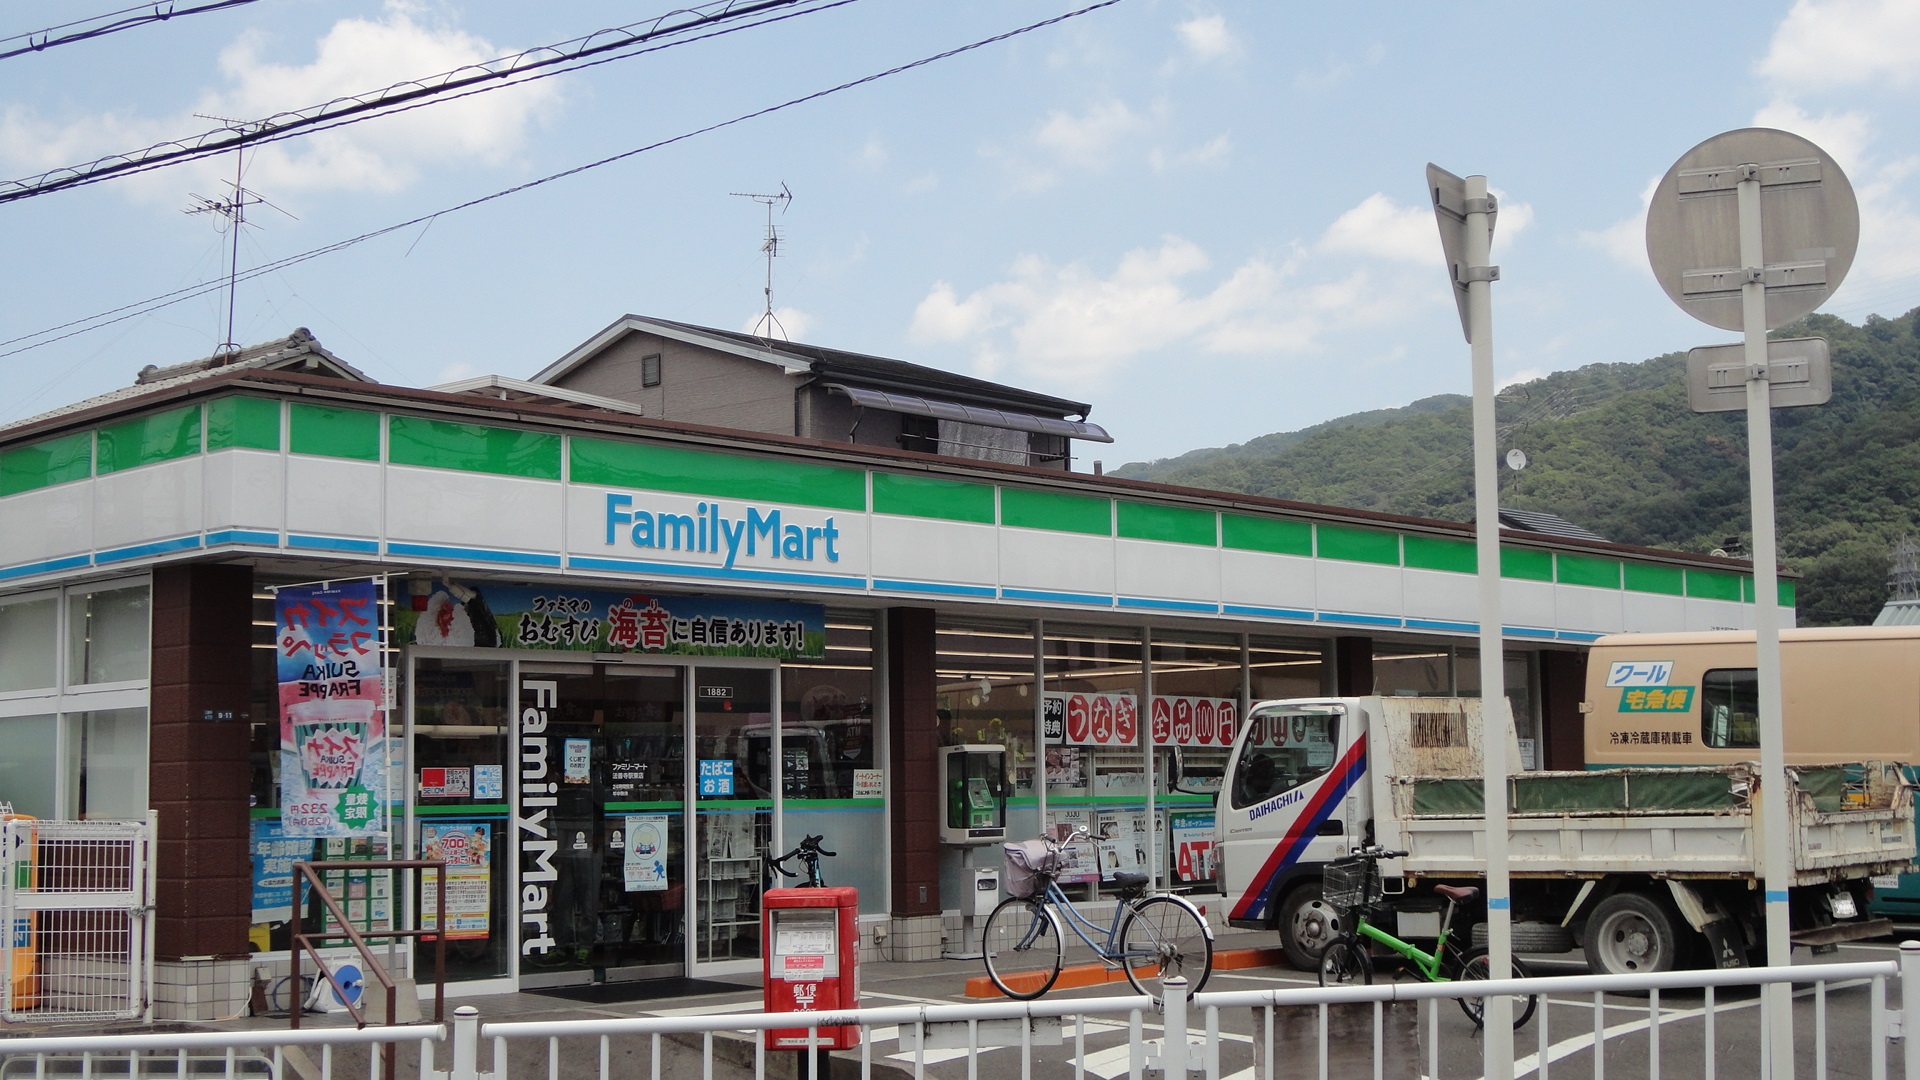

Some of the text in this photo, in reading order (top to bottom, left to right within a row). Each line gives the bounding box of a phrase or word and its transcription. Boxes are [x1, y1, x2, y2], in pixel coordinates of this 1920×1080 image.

[605, 493, 839, 569] FamilyMart
[533, 597, 590, 613] ファミマの
[519, 614, 599, 642] おむすび
[1614, 665, 1667, 684] クール
[707, 688, 727, 696] 1882
[1626, 689, 1688, 710] 宅急便
[1044, 700, 1062, 715] 予約
[1070, 698, 1136, 739] うなぎ
[1153, 701, 1234, 741] 全品100円
[1610, 732, 1692, 745] 冷凍冷蔵庫積載車
[701, 761, 733, 776] たばこ
[704, 779, 730, 793] お酒
[519, 680, 557, 956] FamilyMart
[442, 839, 469, 848] 700円
[793, 983, 817, 997] 郵便
